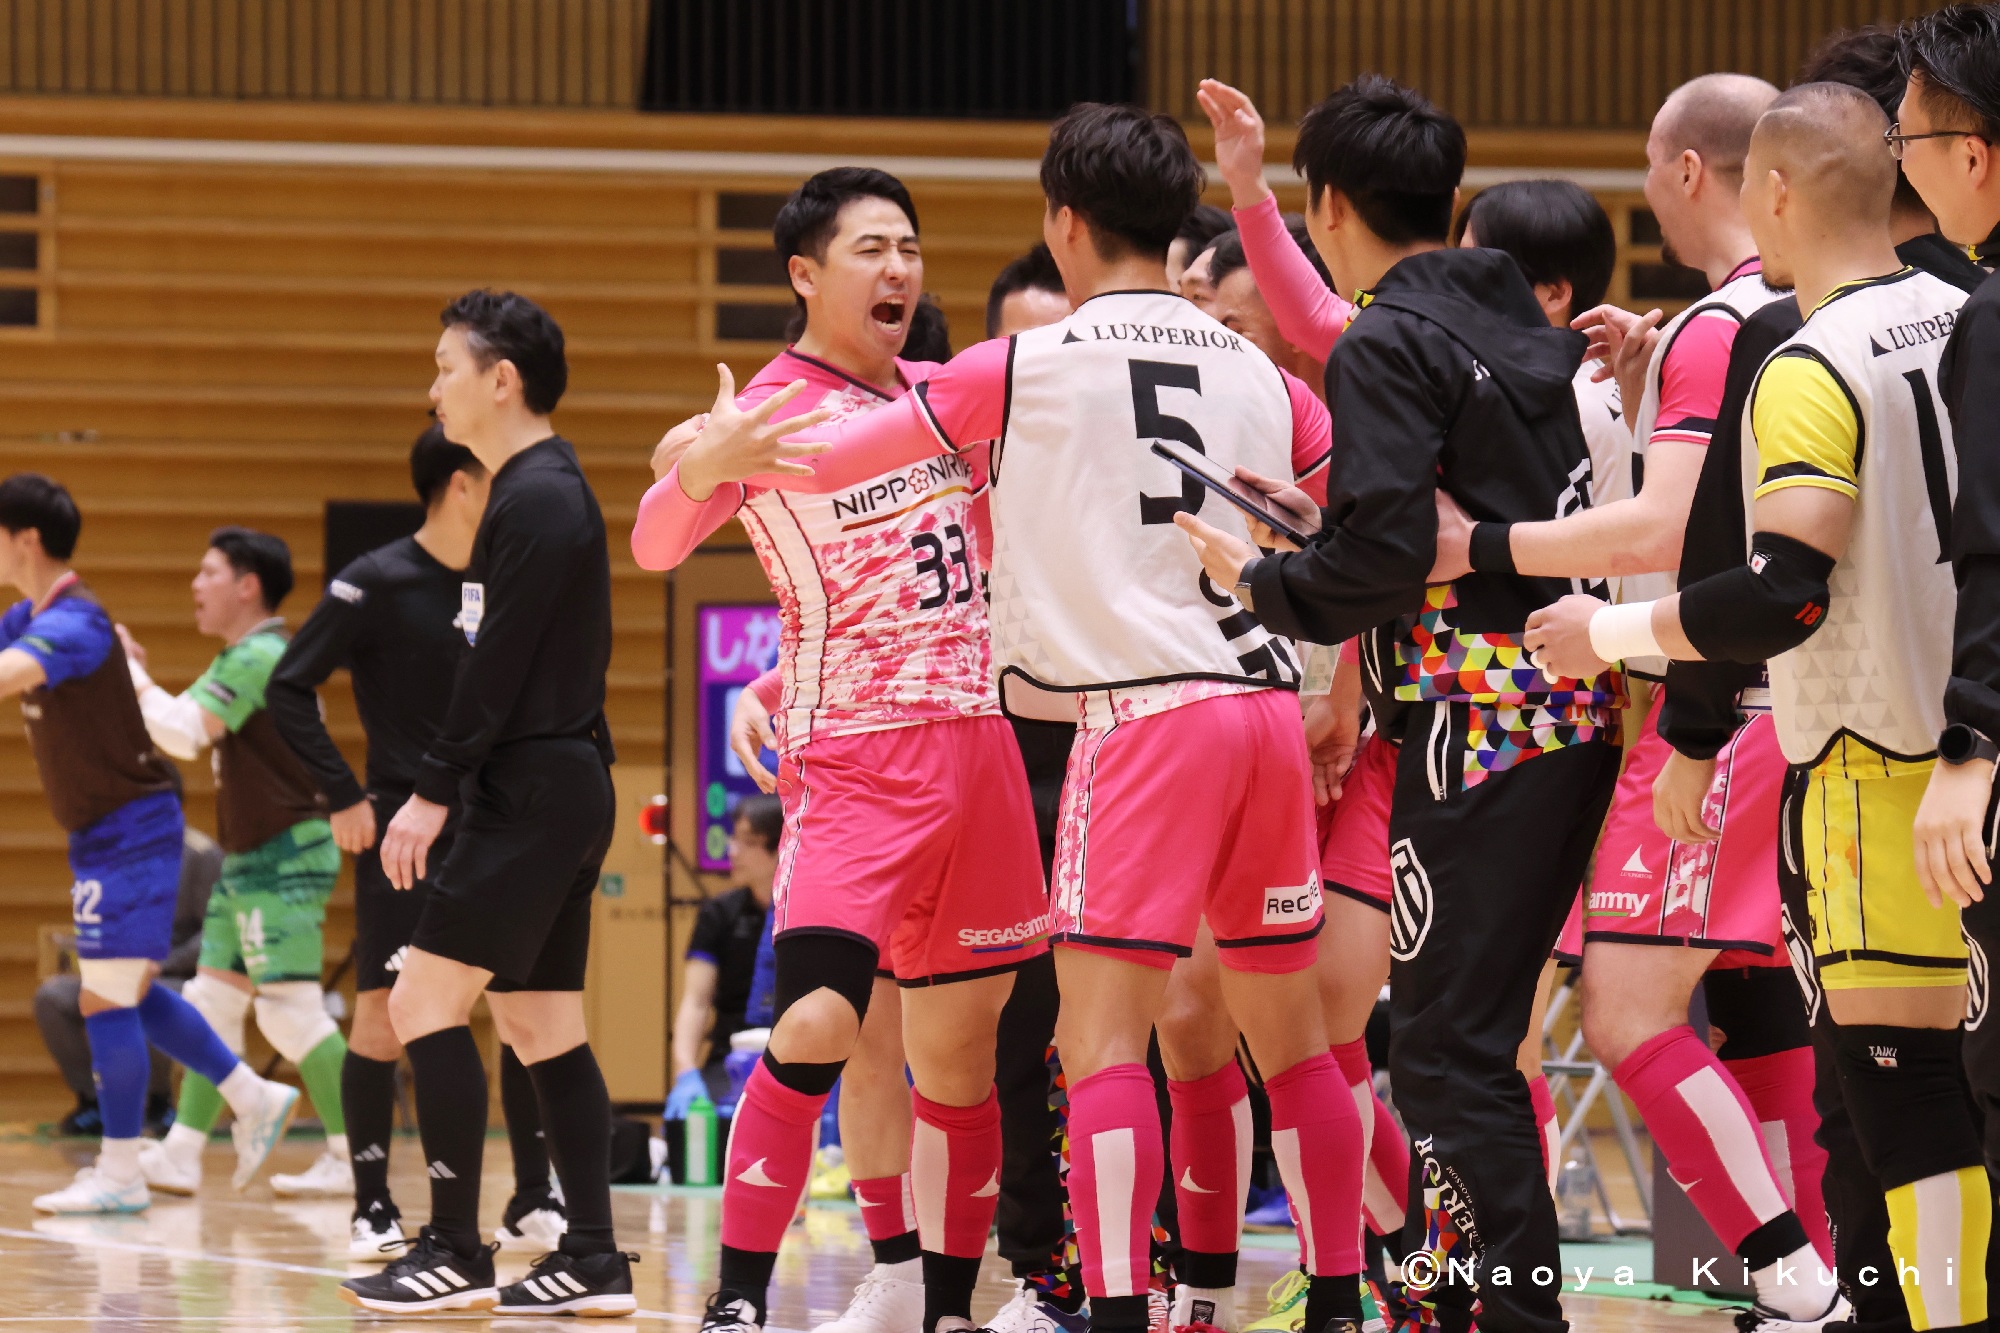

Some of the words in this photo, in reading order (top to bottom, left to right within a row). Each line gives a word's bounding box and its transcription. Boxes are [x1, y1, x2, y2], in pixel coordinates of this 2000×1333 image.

[1092, 323, 1244, 353] LUXPERIOR
[1887, 308, 1961, 350] LUXPER
[1128, 359, 1206, 525] 5
[911, 523, 974, 611] 33
[463, 587, 481, 602] FIFA
[1794, 601, 1822, 625] 18
[707, 613, 780, 674] しな
[1588, 891, 1650, 918] ammy
[1868, 1045, 1898, 1058] TAIKI
